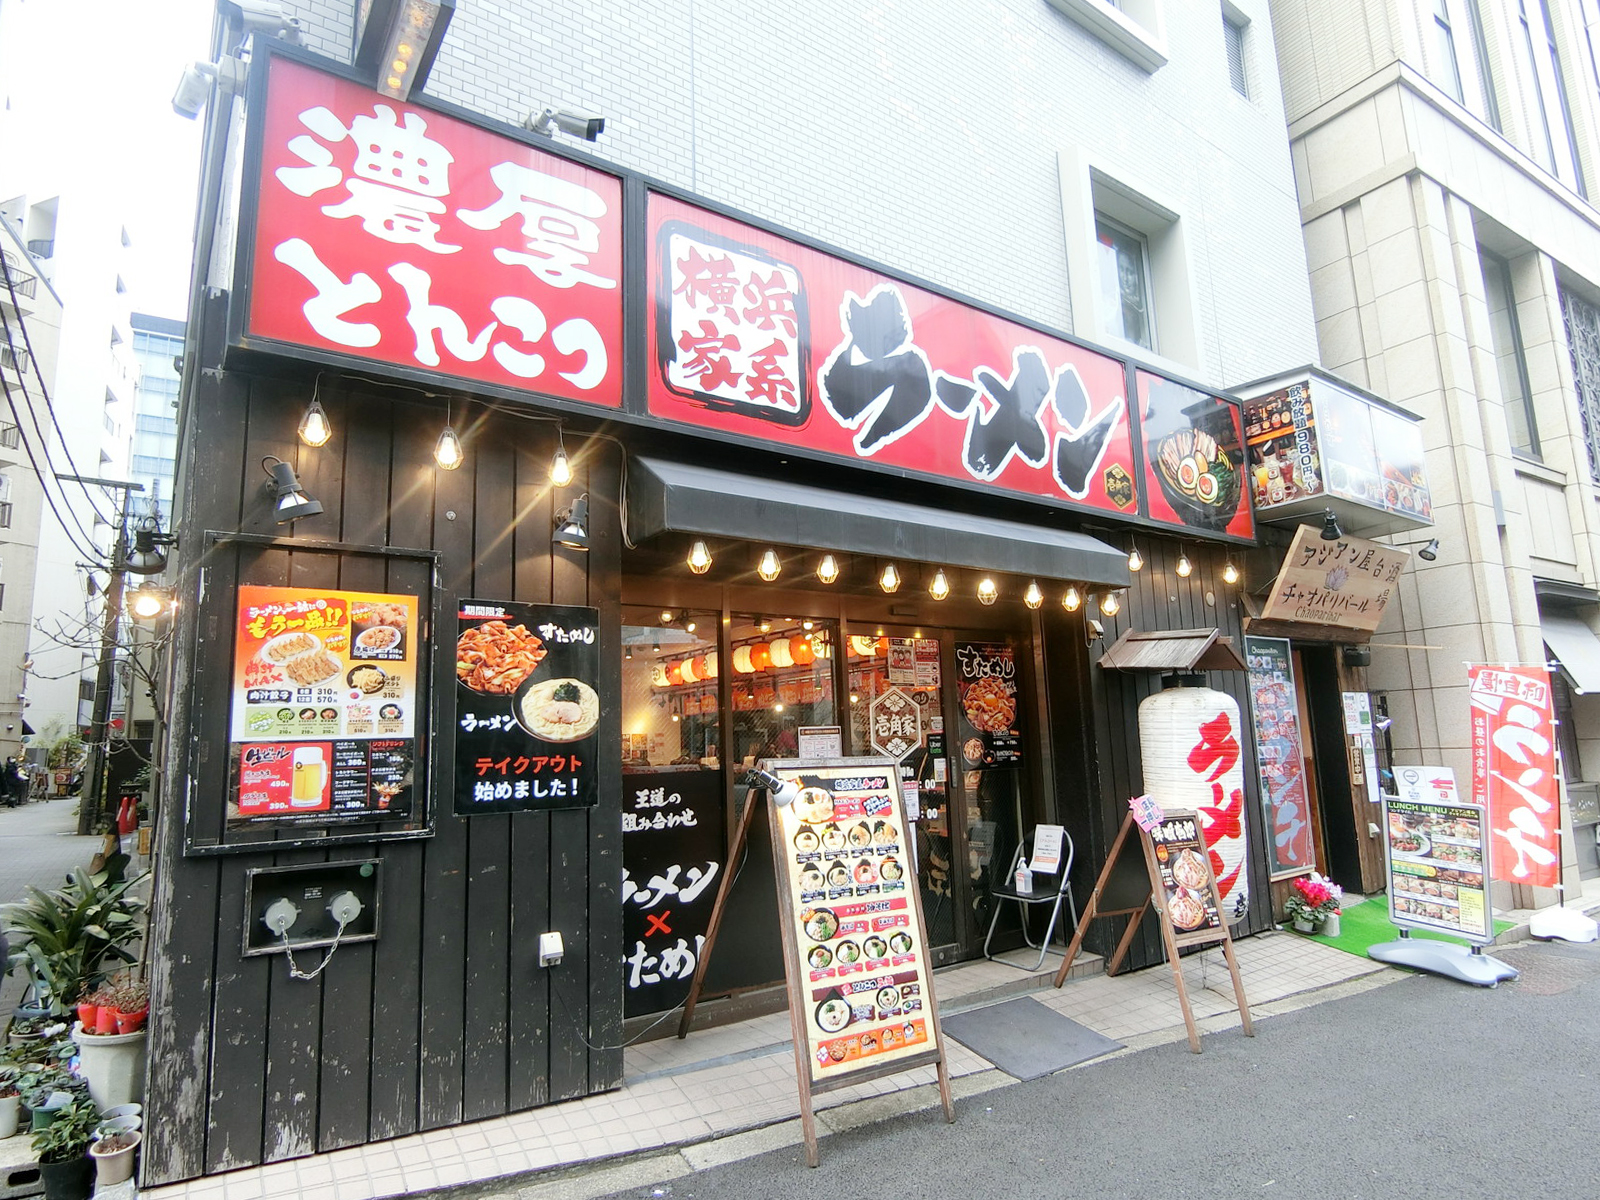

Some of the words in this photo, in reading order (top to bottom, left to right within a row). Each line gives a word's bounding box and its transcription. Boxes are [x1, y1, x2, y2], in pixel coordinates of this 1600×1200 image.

[275, 104, 616, 289] 濃厚
[675, 244, 798, 340] 横浜
[274, 237, 608, 391] とんこつ
[675, 318, 798, 410] 家系
[816, 281, 1125, 500] ラーメン
[464, 605, 505, 618] 期間限定
[539, 622, 595, 645] すためし
[956, 645, 1015, 679] すためし
[461, 713, 517, 732] ラーメン
[875, 713, 916, 737] 壱角家
[475, 755, 582, 776] テイクアウト
[635, 787, 682, 809] 王道の
[1387, 801, 1418, 810] LUNCH
[1421, 804, 1448, 814] MENU
